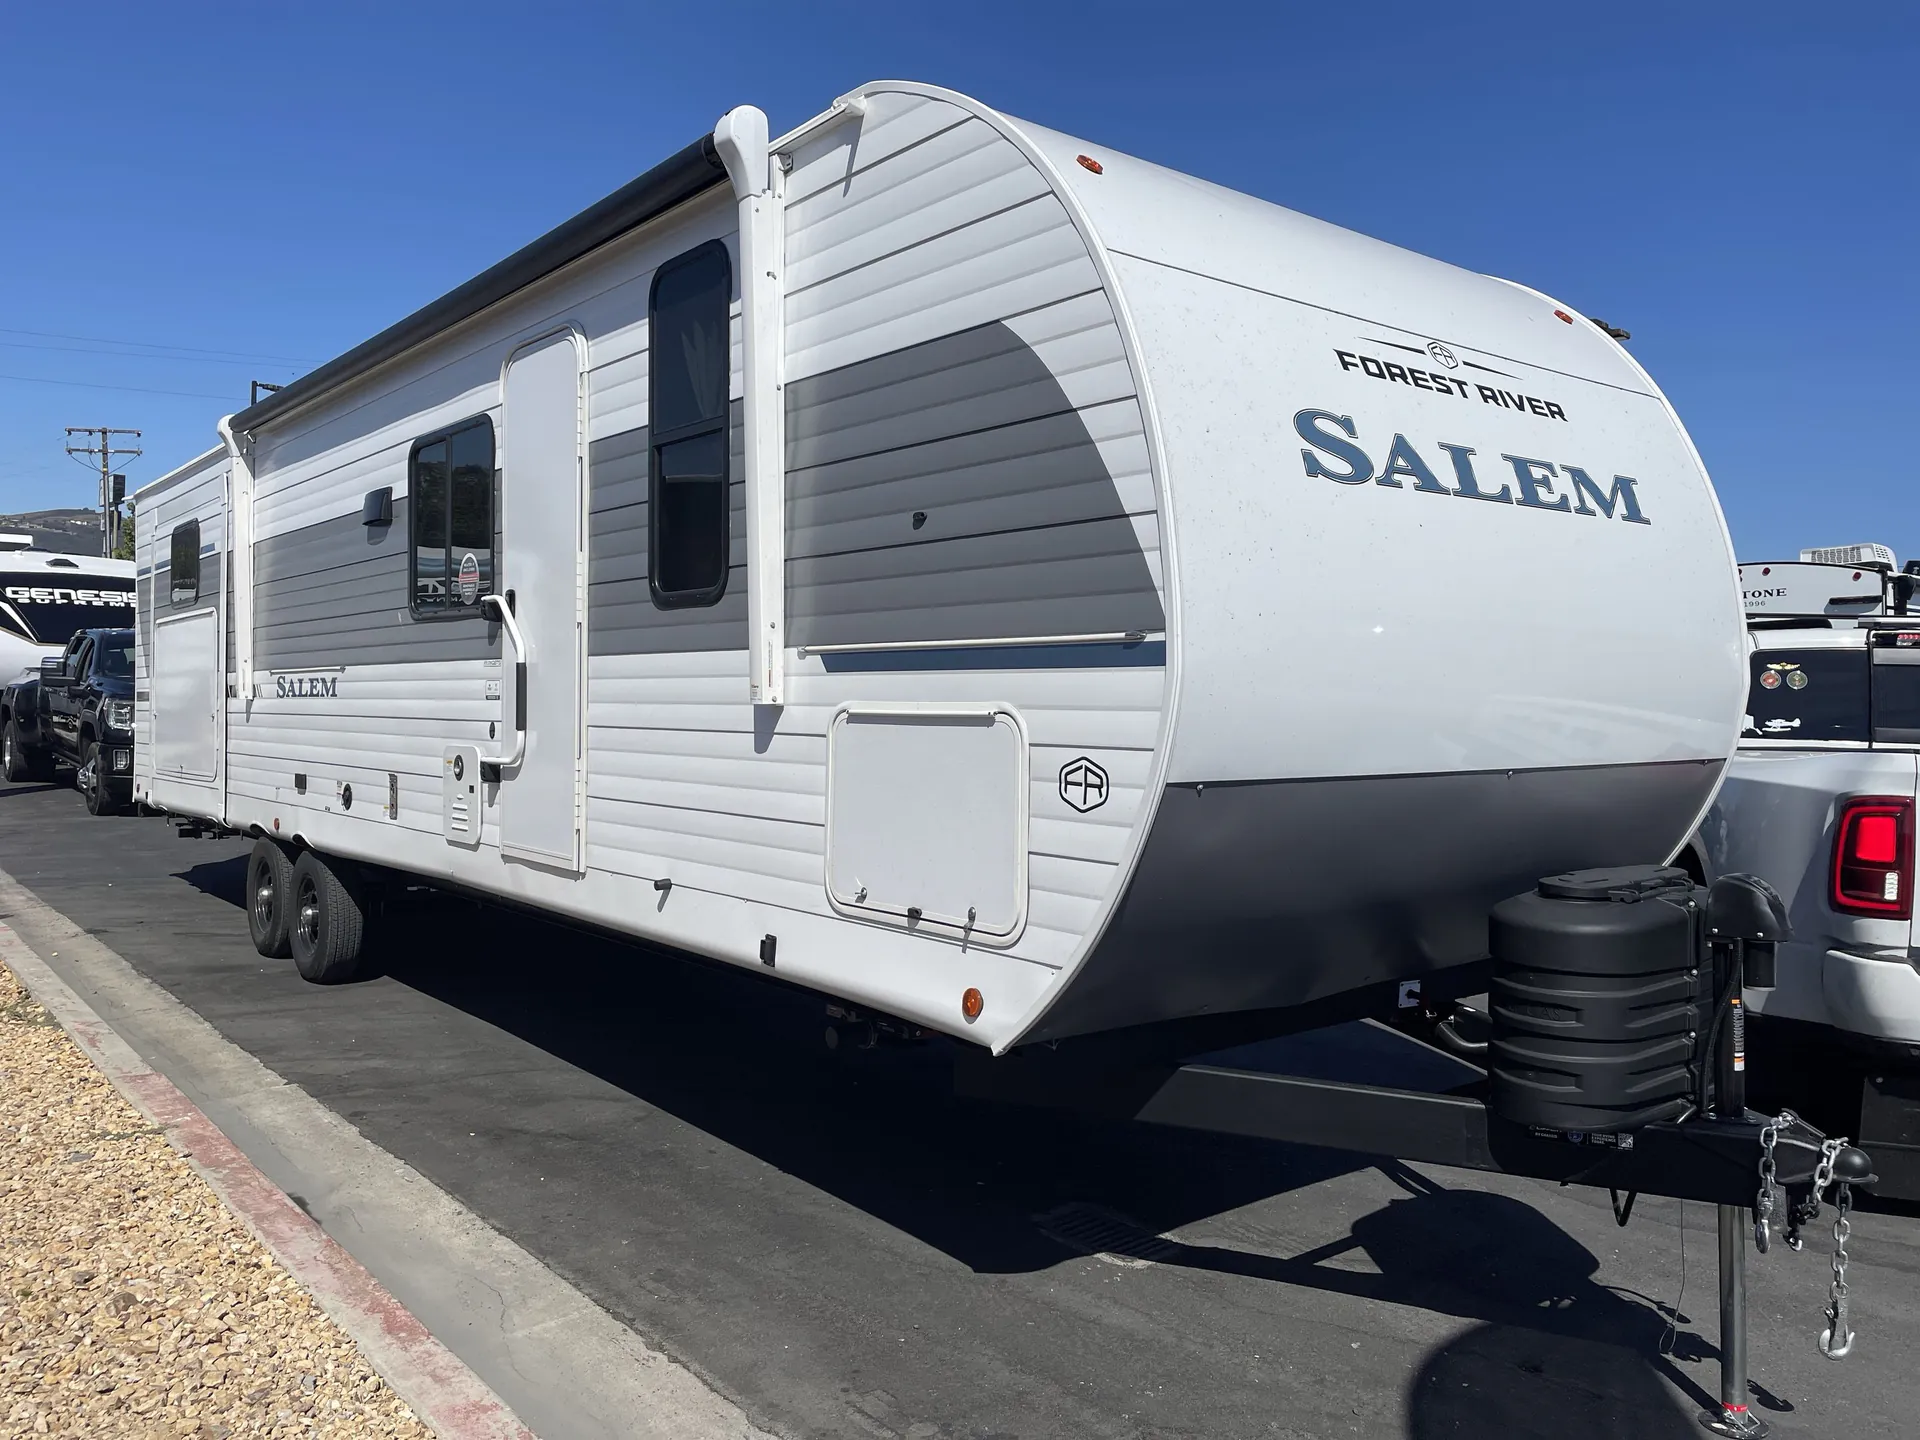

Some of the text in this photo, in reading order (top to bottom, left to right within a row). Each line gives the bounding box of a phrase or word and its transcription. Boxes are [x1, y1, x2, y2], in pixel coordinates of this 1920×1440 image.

[1333, 349, 1569, 423] FOREST RIVER
[1293, 408, 1651, 525] SALEM
[1742, 588, 1787, 599] TONE
[276, 675, 338, 699] SALEM
